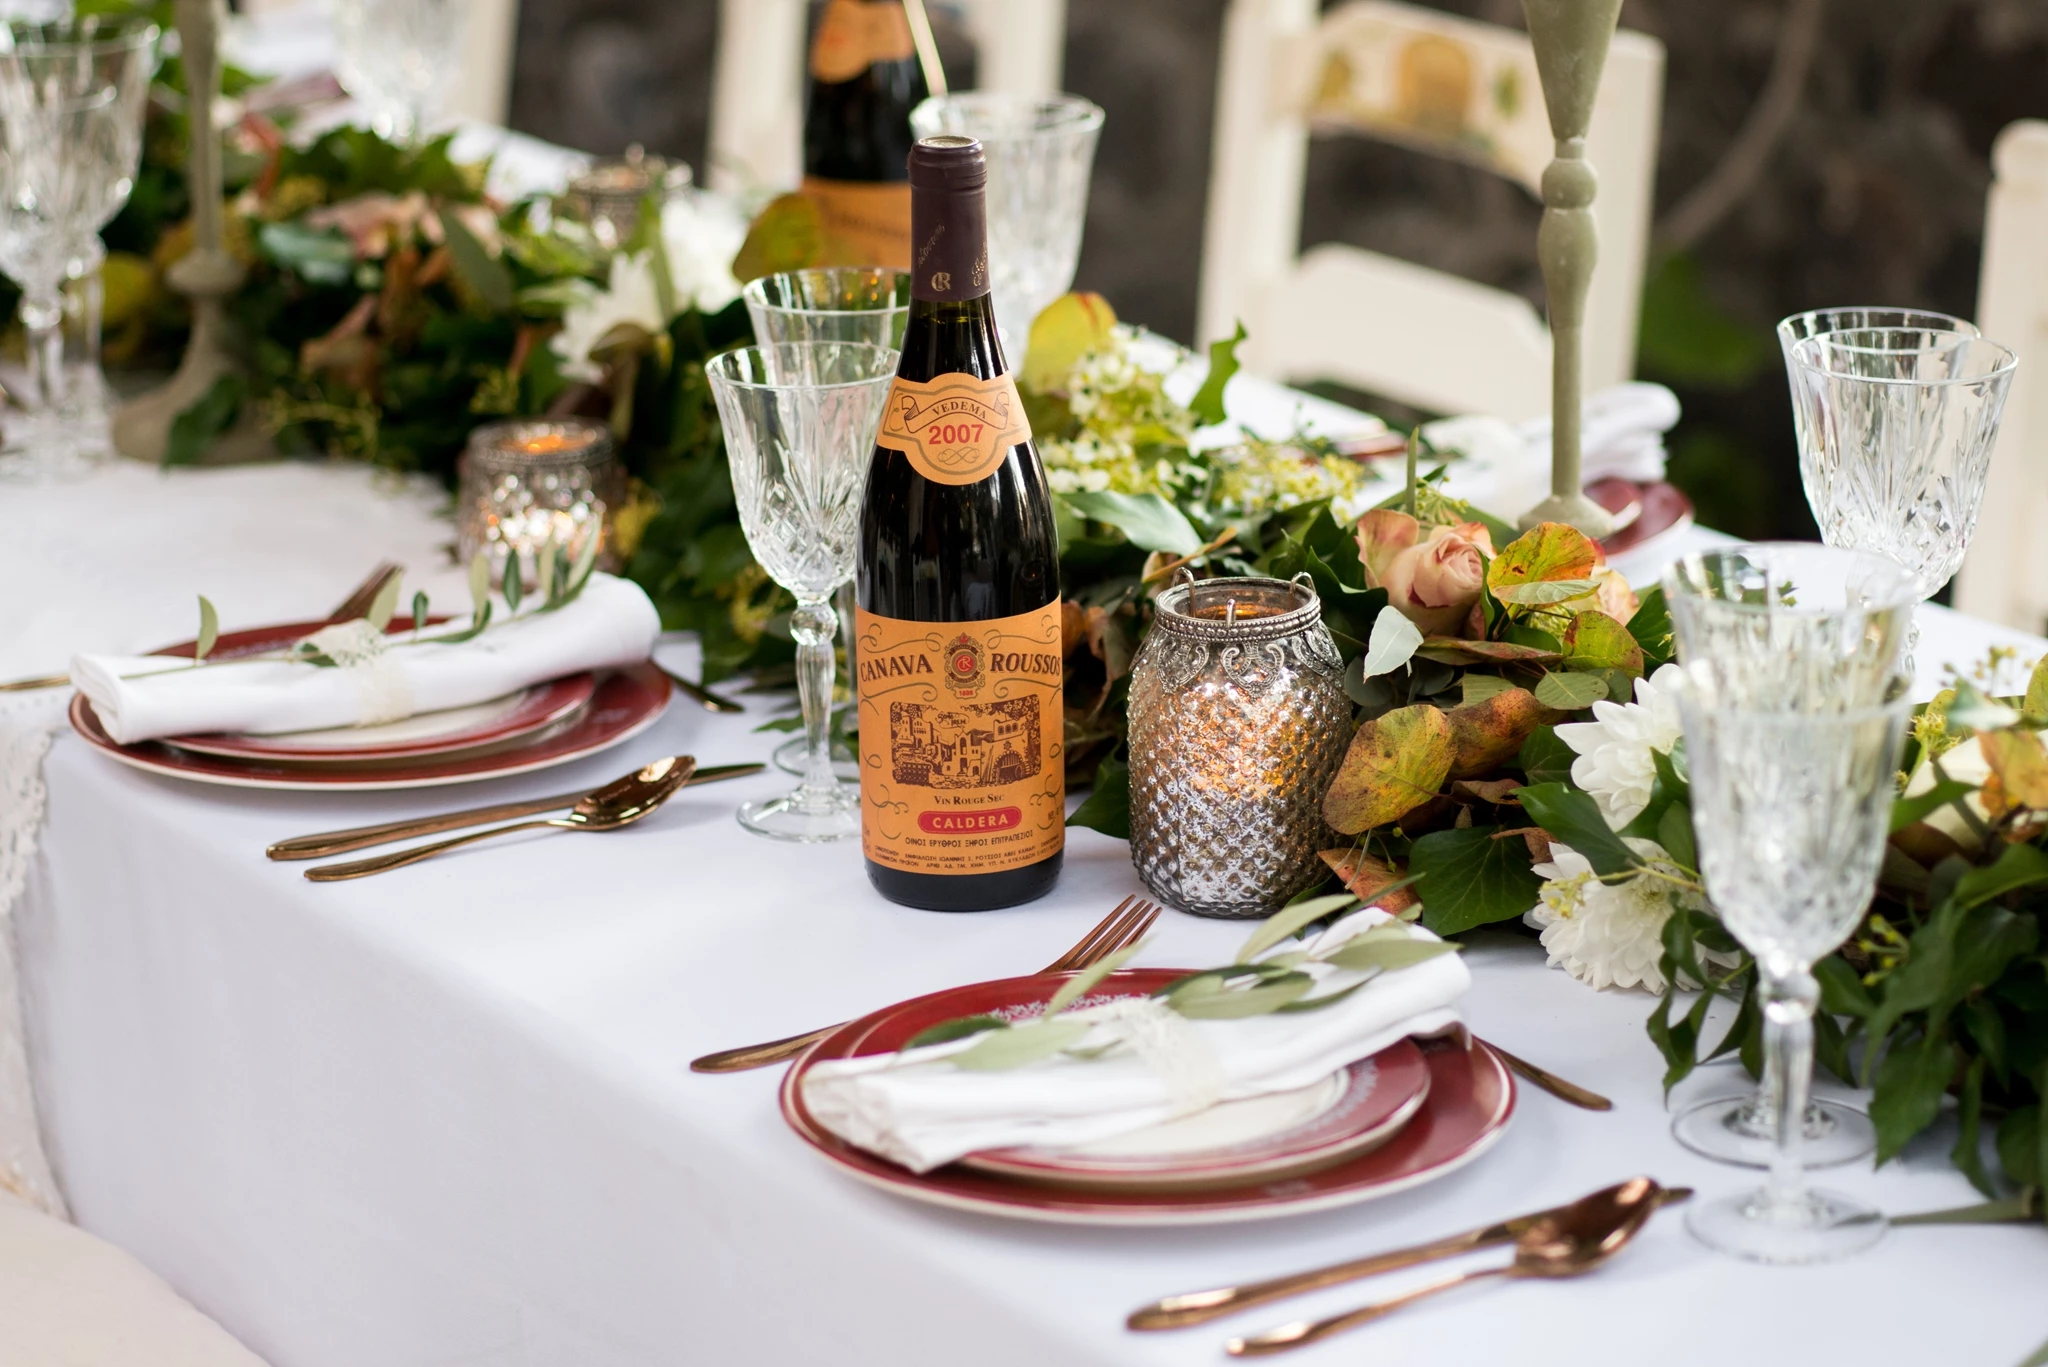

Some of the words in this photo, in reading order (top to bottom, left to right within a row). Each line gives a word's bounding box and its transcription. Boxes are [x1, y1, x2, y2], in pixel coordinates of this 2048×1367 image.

[932, 401, 986, 419] VEDEMA
[928, 423, 984, 445] 2007
[860, 653, 934, 682] CANAVA
[990, 652, 1061, 677] ROUSSOS
[932, 813, 1009, 829] CALDERA
[929, 839, 961, 848] ΕΡΥΘΡΟΣ
